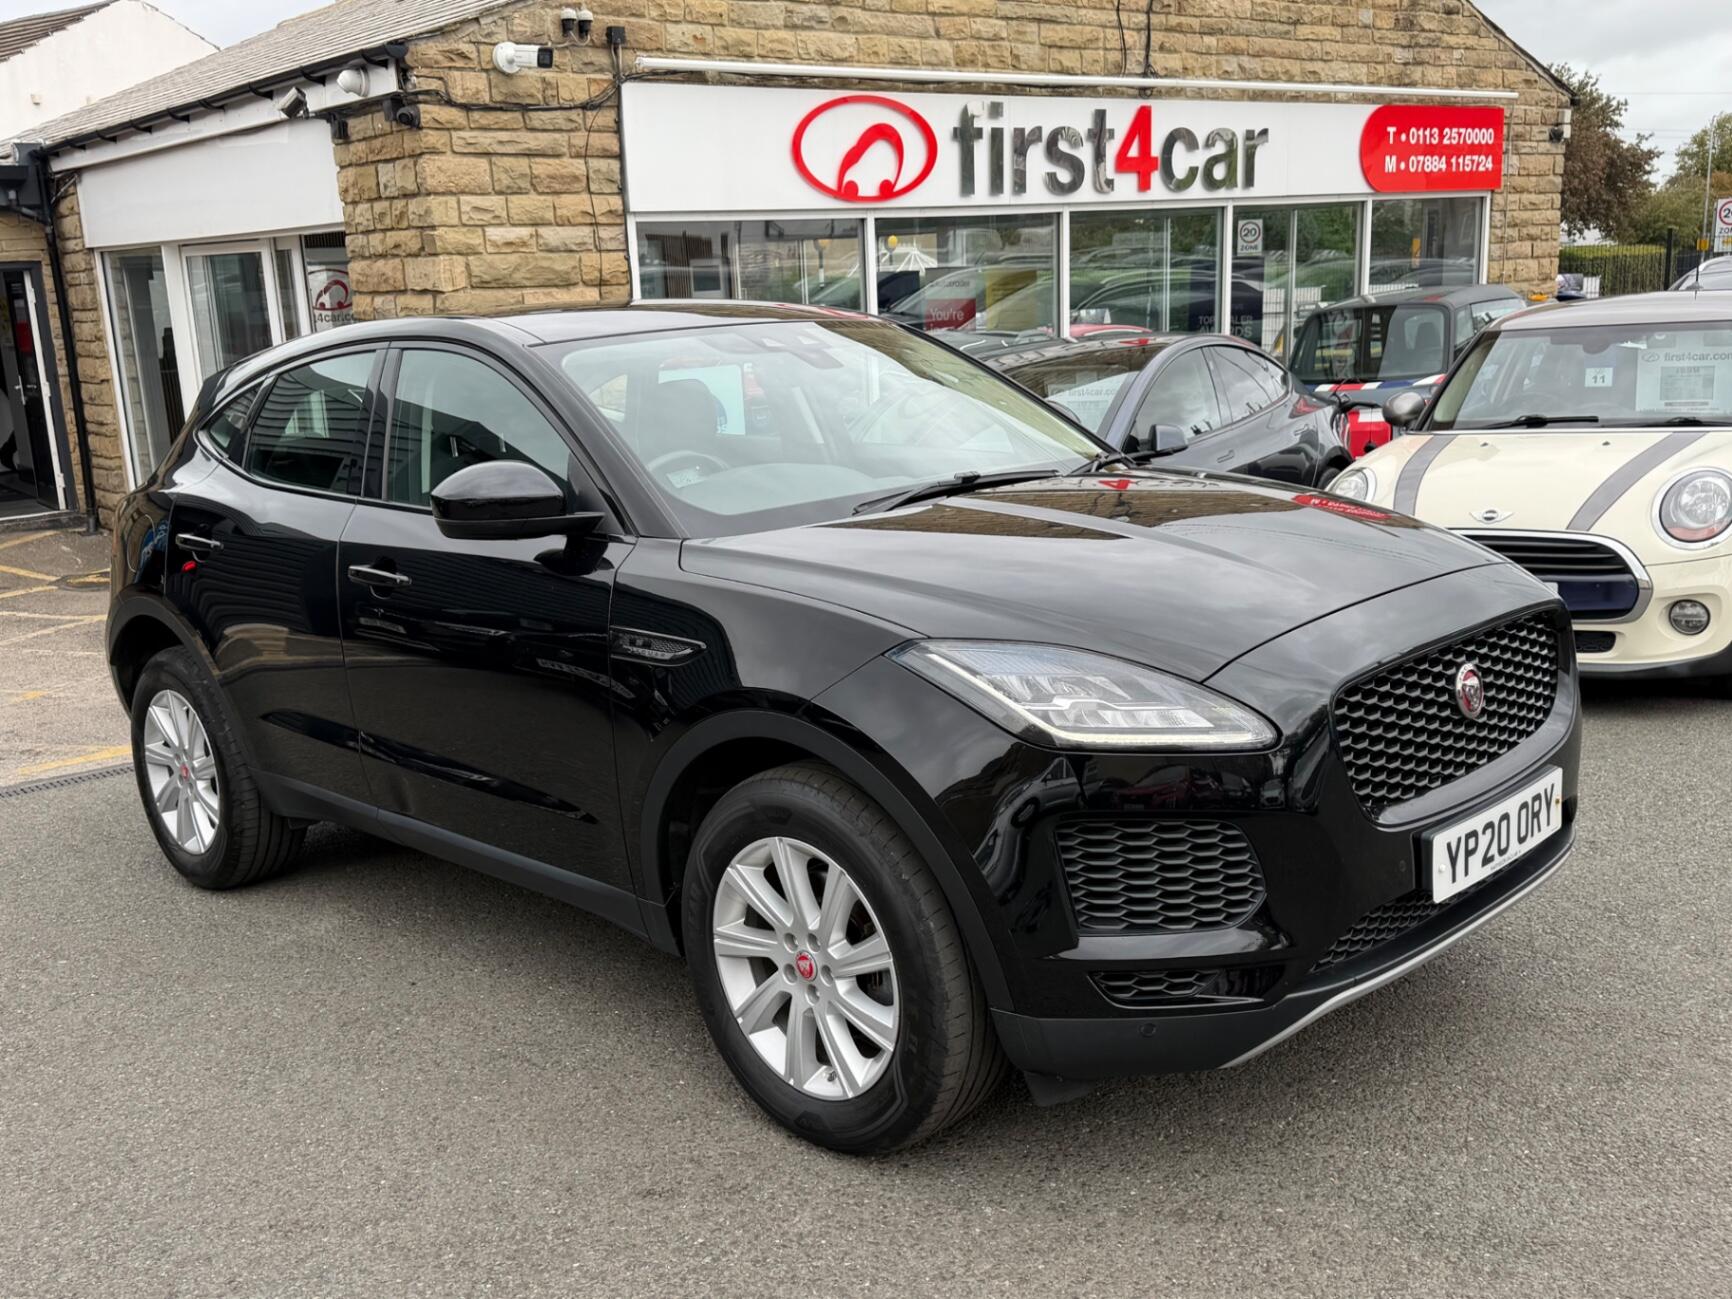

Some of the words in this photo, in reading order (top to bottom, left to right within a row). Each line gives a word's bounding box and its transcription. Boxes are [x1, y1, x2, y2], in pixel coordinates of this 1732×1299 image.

[1387, 126, 1397, 145] T
[1409, 127, 1439, 145] 0113
[1443, 127, 1494, 145] 2570000
[952, 101, 1269, 196] first4car
[1385, 155, 1397, 173] M
[1409, 155, 1446, 173] 07884
[1450, 155, 1493, 173] 115724
[1243, 227, 1257, 238] 20
[929, 307, 965, 321] You're
[1591, 375, 1606, 384] 11
[1446, 811, 1511, 884] YP20
[1516, 783, 1555, 845] ORY
